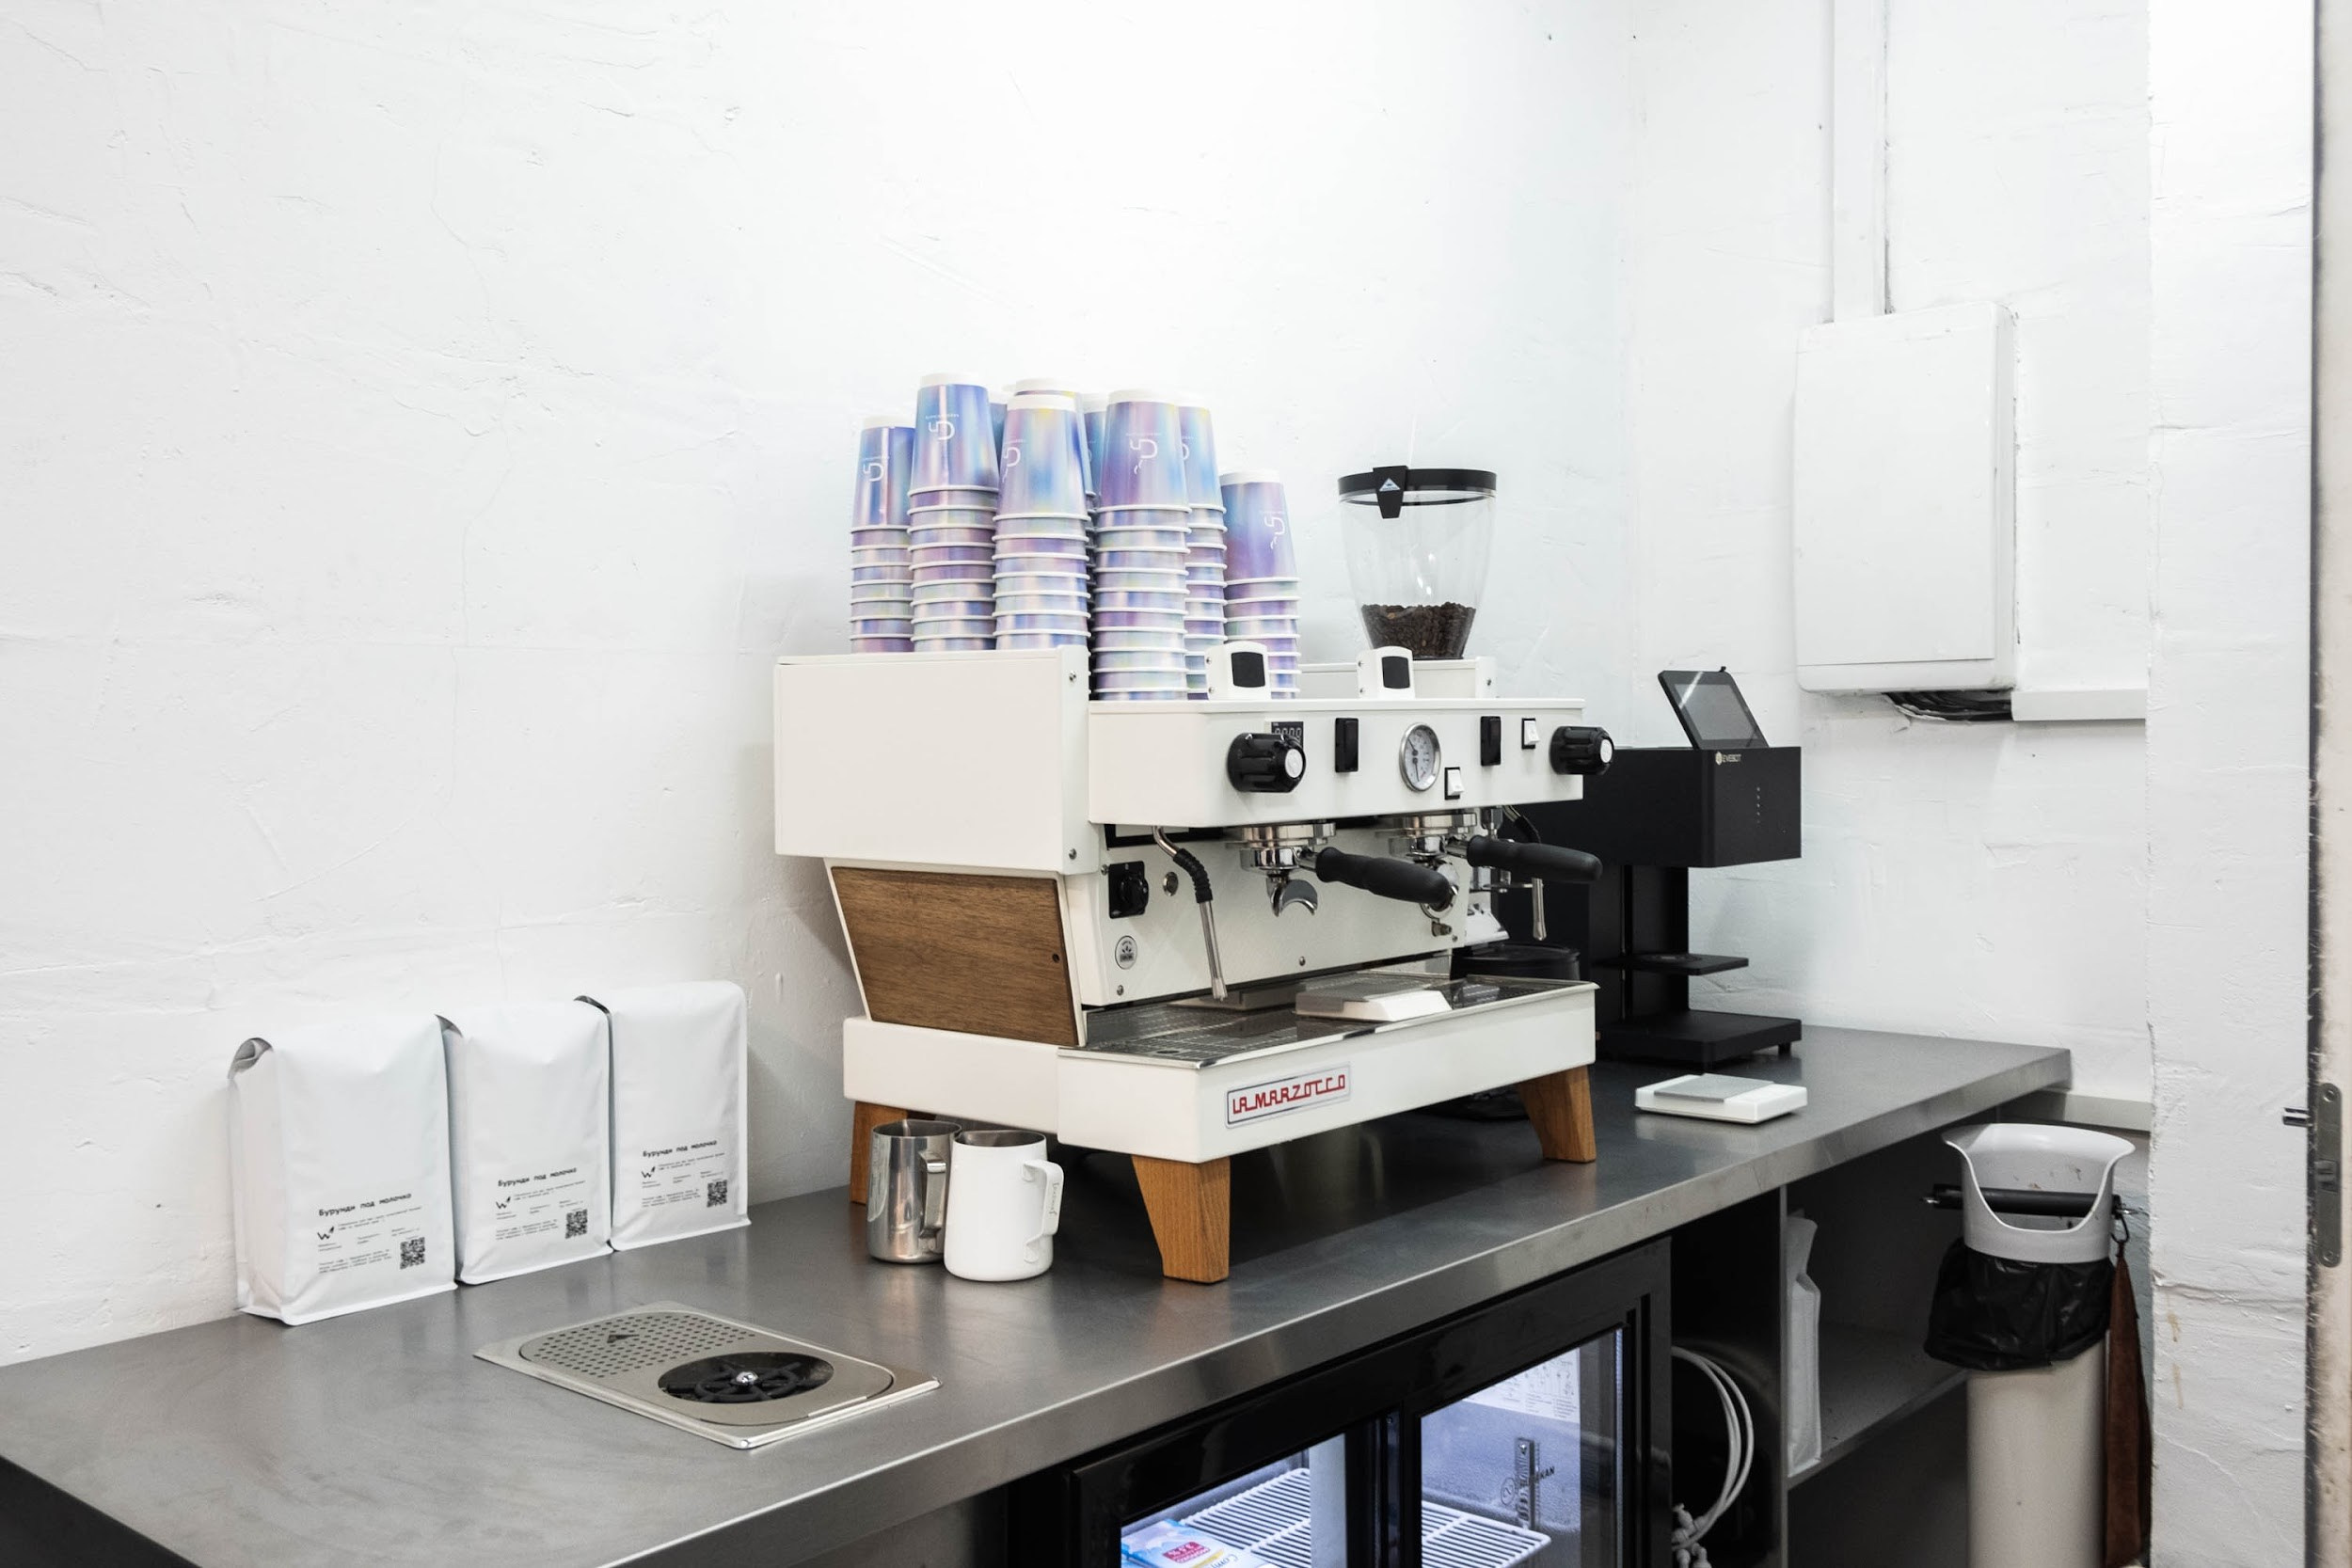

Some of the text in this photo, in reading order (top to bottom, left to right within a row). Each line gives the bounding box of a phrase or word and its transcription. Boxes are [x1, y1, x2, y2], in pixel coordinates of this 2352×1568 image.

[1232, 1074, 1345, 1115] LA MARZOCCO
[498, 1178, 530, 1187] Бурунди
[319, 1206, 356, 1216] Бурунди
[379, 1194, 411, 1204] молочко
